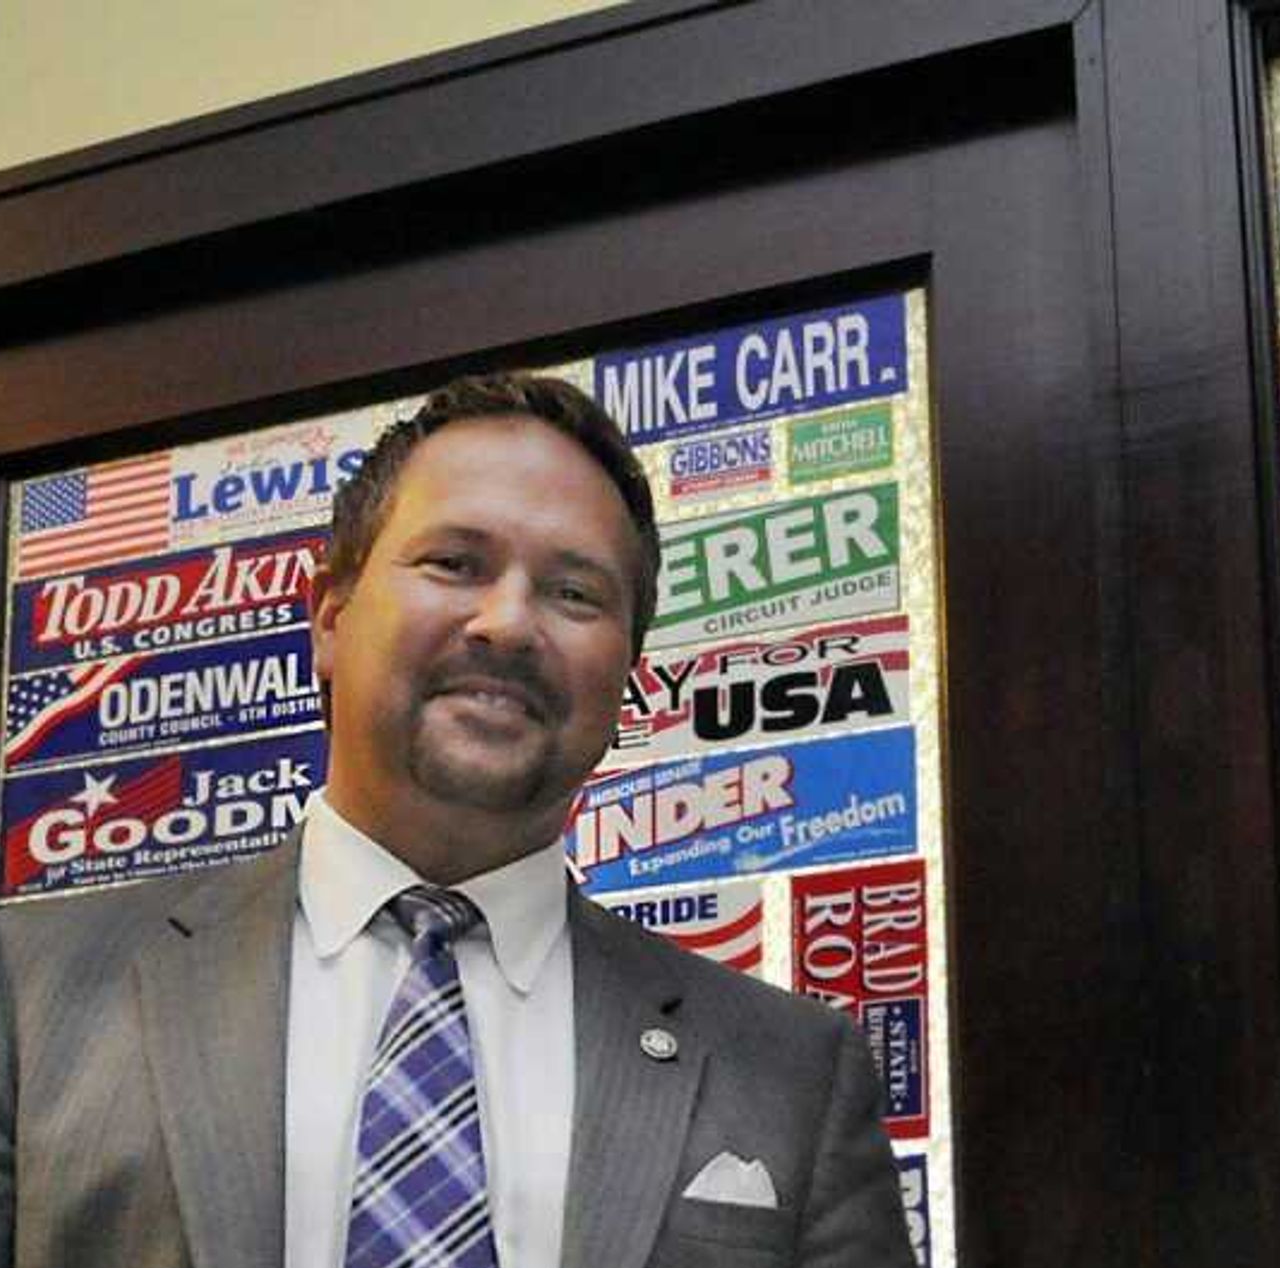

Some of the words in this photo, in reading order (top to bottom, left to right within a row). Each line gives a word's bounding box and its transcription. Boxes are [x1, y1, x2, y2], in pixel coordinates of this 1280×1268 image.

[604, 344, 718, 440] MIKE
[735, 313, 871, 411] CARR
[670, 428, 771, 477] GIBBONS
[36, 567, 181, 642] TODD
[73, 634, 123, 659] U.S.
[134, 602, 293, 648] CONGRESS
[703, 595, 801, 635] CIRCUIT
[811, 570, 891, 606] JUDGE
[719, 636, 859, 674] FOR
[99, 653, 320, 727] ODENWAL
[693, 661, 893, 741] USA
[99, 726, 156, 747] COUNTY
[160, 714, 224, 738] COUNCIL
[183, 758, 311, 807] Jack
[69, 854, 128, 875] State
[629, 836, 733, 877] Expanding
[779, 791, 907, 848] Freedom
[861, 880, 921, 993] BRAD
